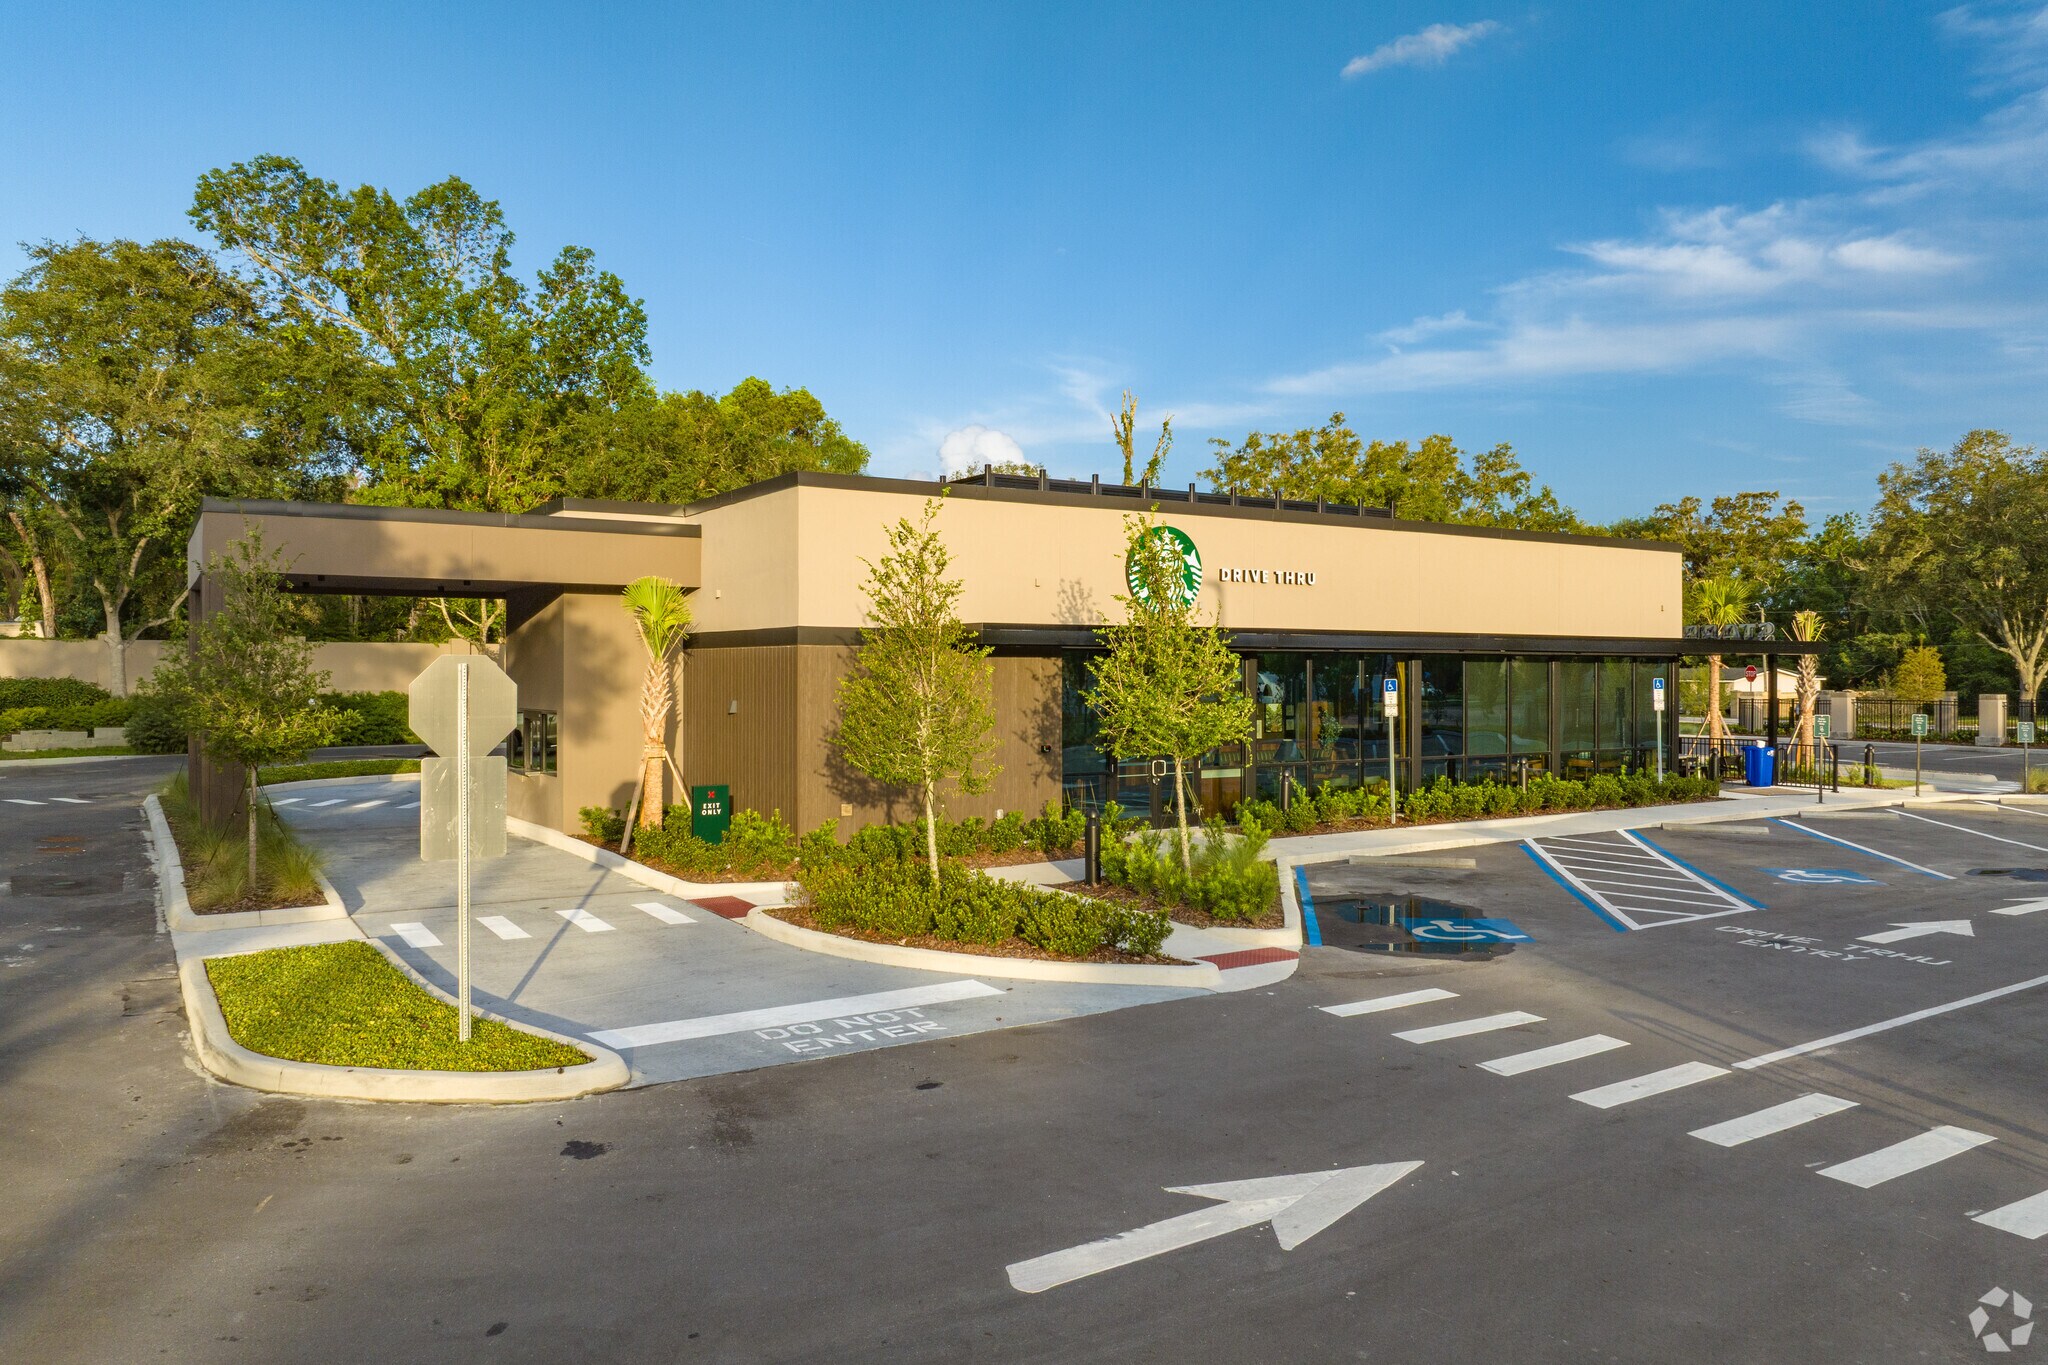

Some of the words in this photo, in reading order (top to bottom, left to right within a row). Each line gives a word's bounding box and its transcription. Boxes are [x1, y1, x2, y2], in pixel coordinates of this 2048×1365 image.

[1219, 567, 1269, 584] DRIVE
[1273, 570, 1316, 587] THRU
[1745, 670, 1756, 678] STOP
[1714, 925, 1823, 945] DRIVE
[1737, 938, 1870, 961] ENTRY
[754, 1023, 823, 1041] DO
[833, 1007, 926, 1029] NOT
[781, 1020, 948, 1053] ENTER
